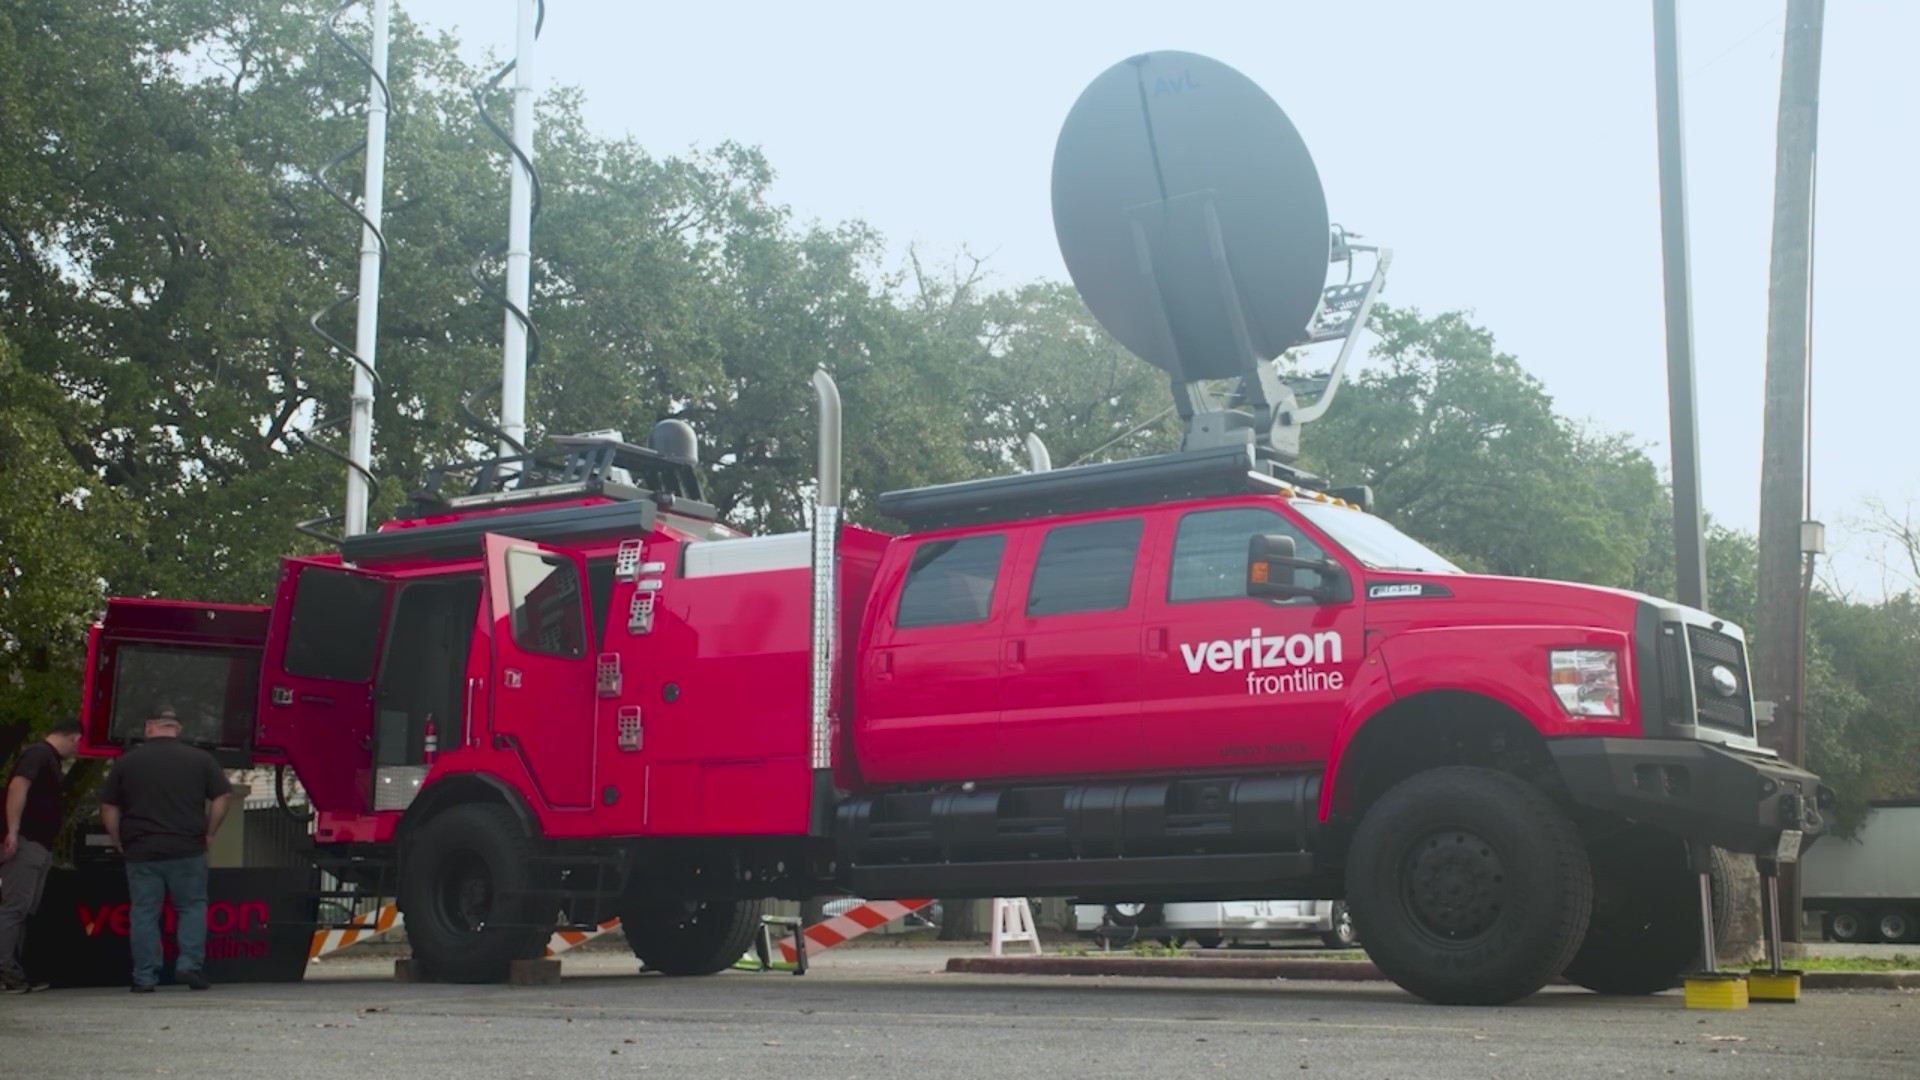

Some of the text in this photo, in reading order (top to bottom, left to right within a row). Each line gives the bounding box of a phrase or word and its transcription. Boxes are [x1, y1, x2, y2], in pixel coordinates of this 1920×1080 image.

[1180, 627, 1343, 674] verizon
[1246, 668, 1344, 696] frontline
[76, 892, 269, 937] veion
